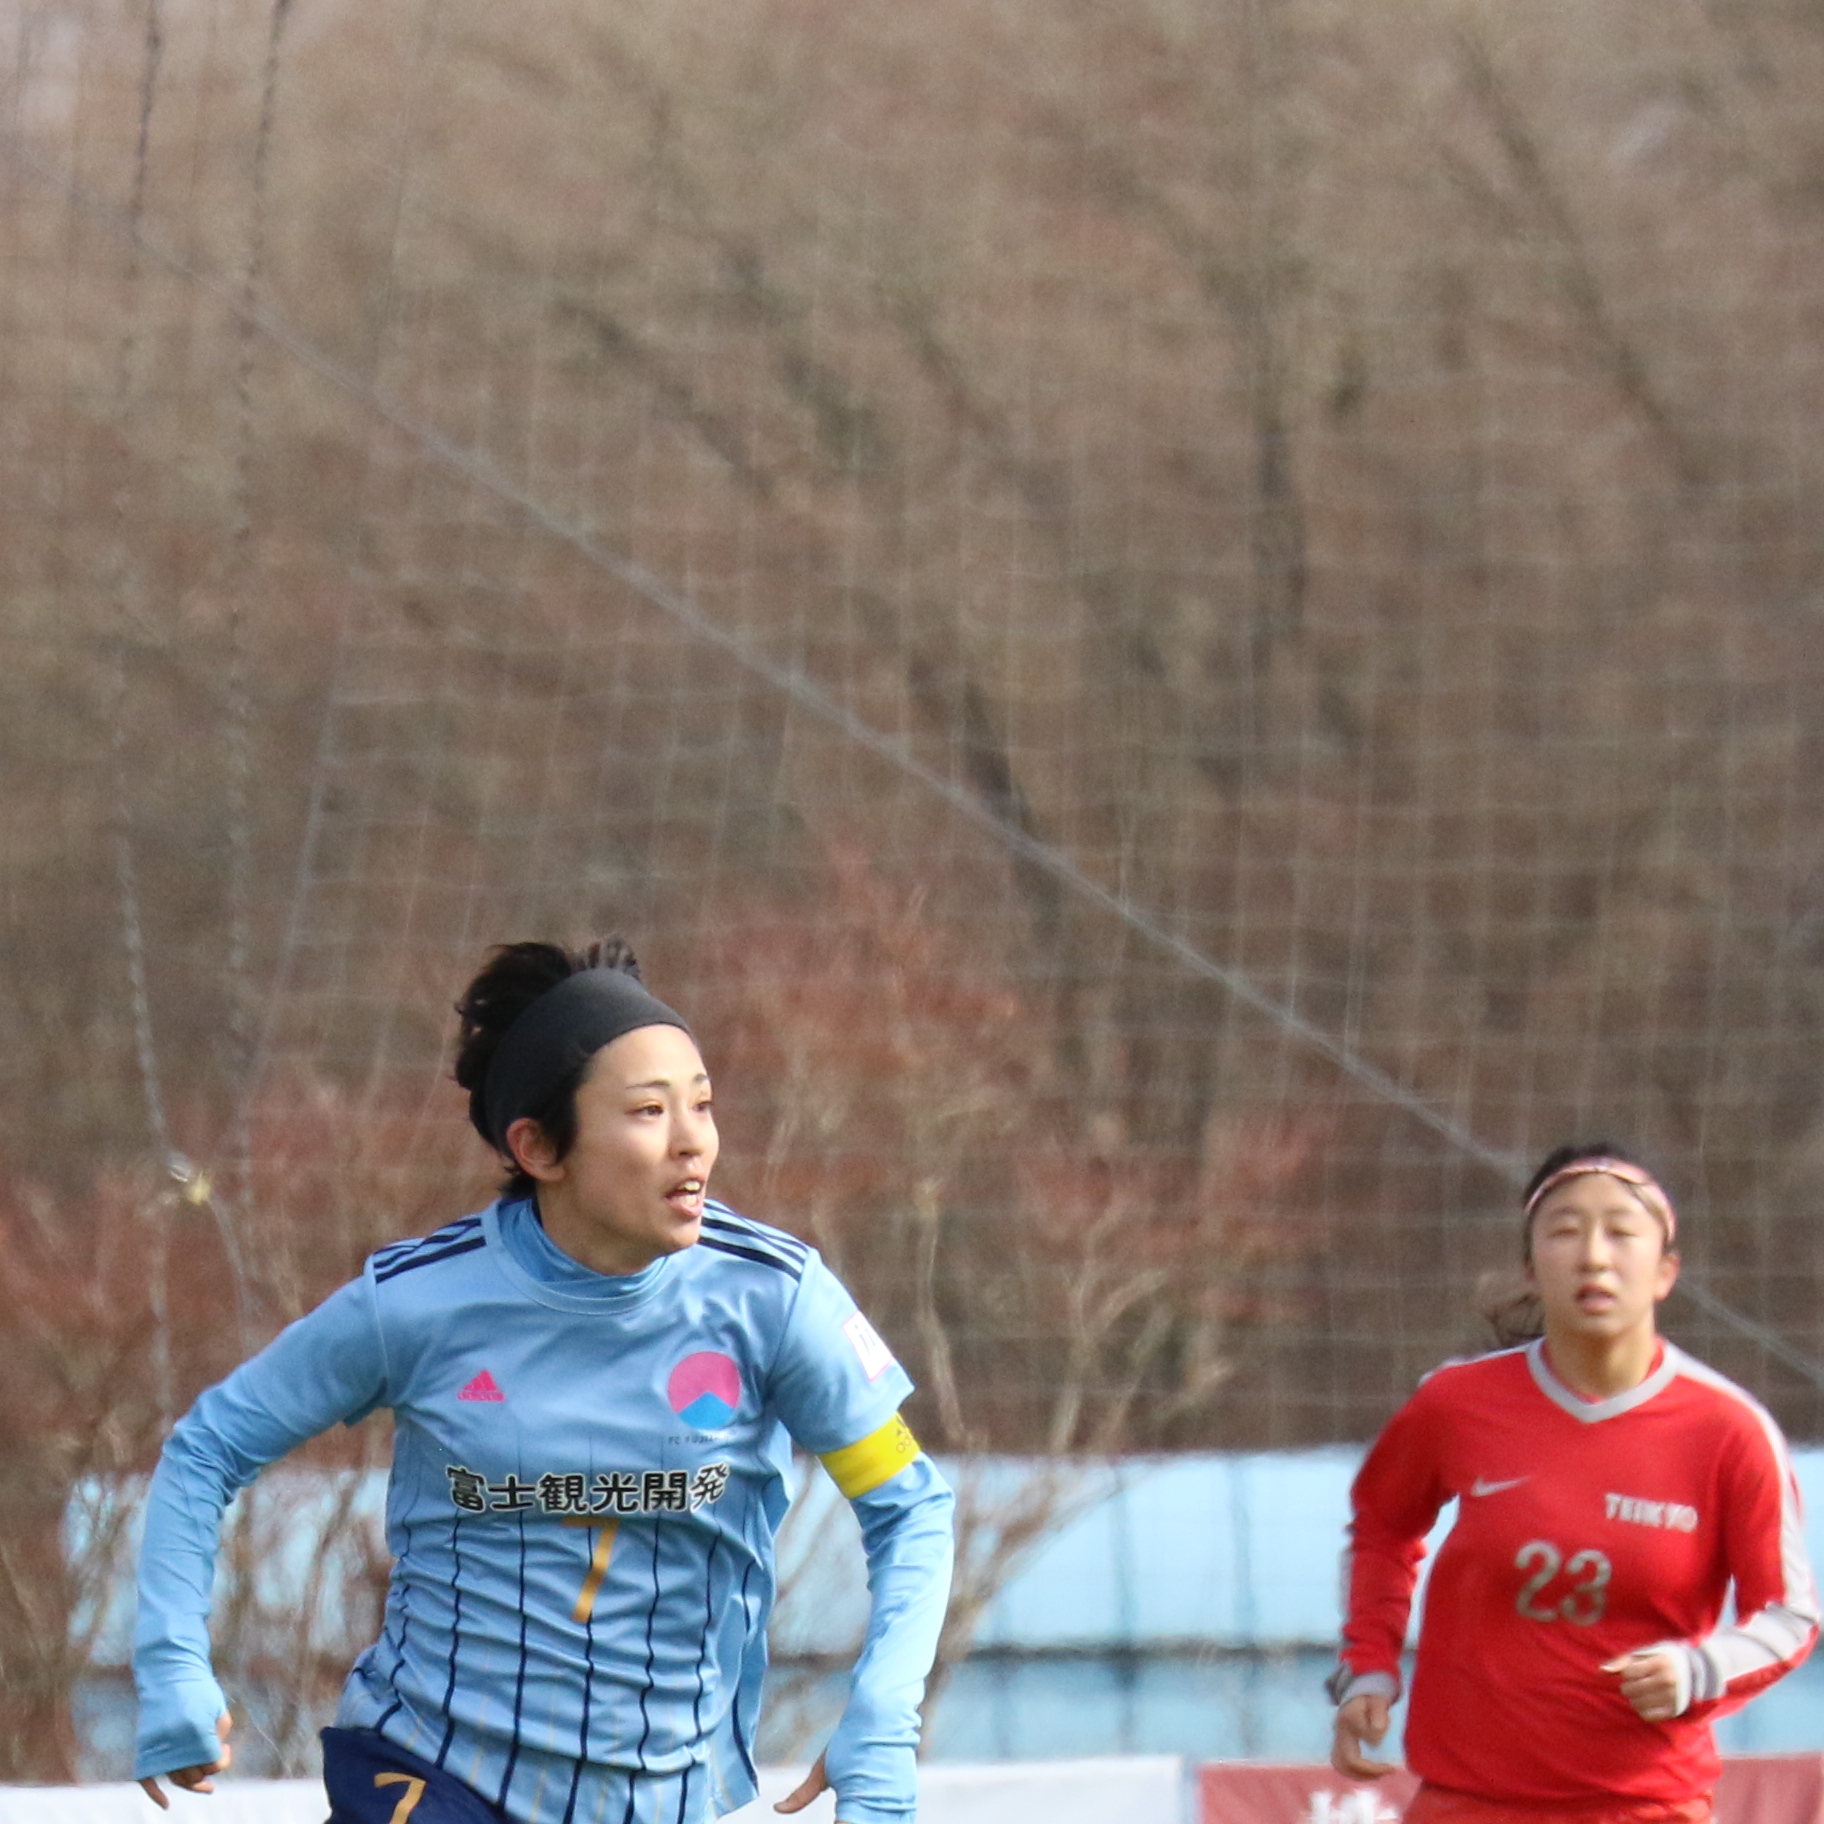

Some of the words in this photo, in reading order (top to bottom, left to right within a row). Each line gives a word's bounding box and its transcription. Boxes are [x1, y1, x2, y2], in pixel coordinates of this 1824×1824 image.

[445, 1462, 730, 1514] 富士観光開発
[1604, 1492, 1698, 1533] TEIKYO
[562, 1516, 621, 1623] 7
[1514, 1539, 1613, 1626] 23
